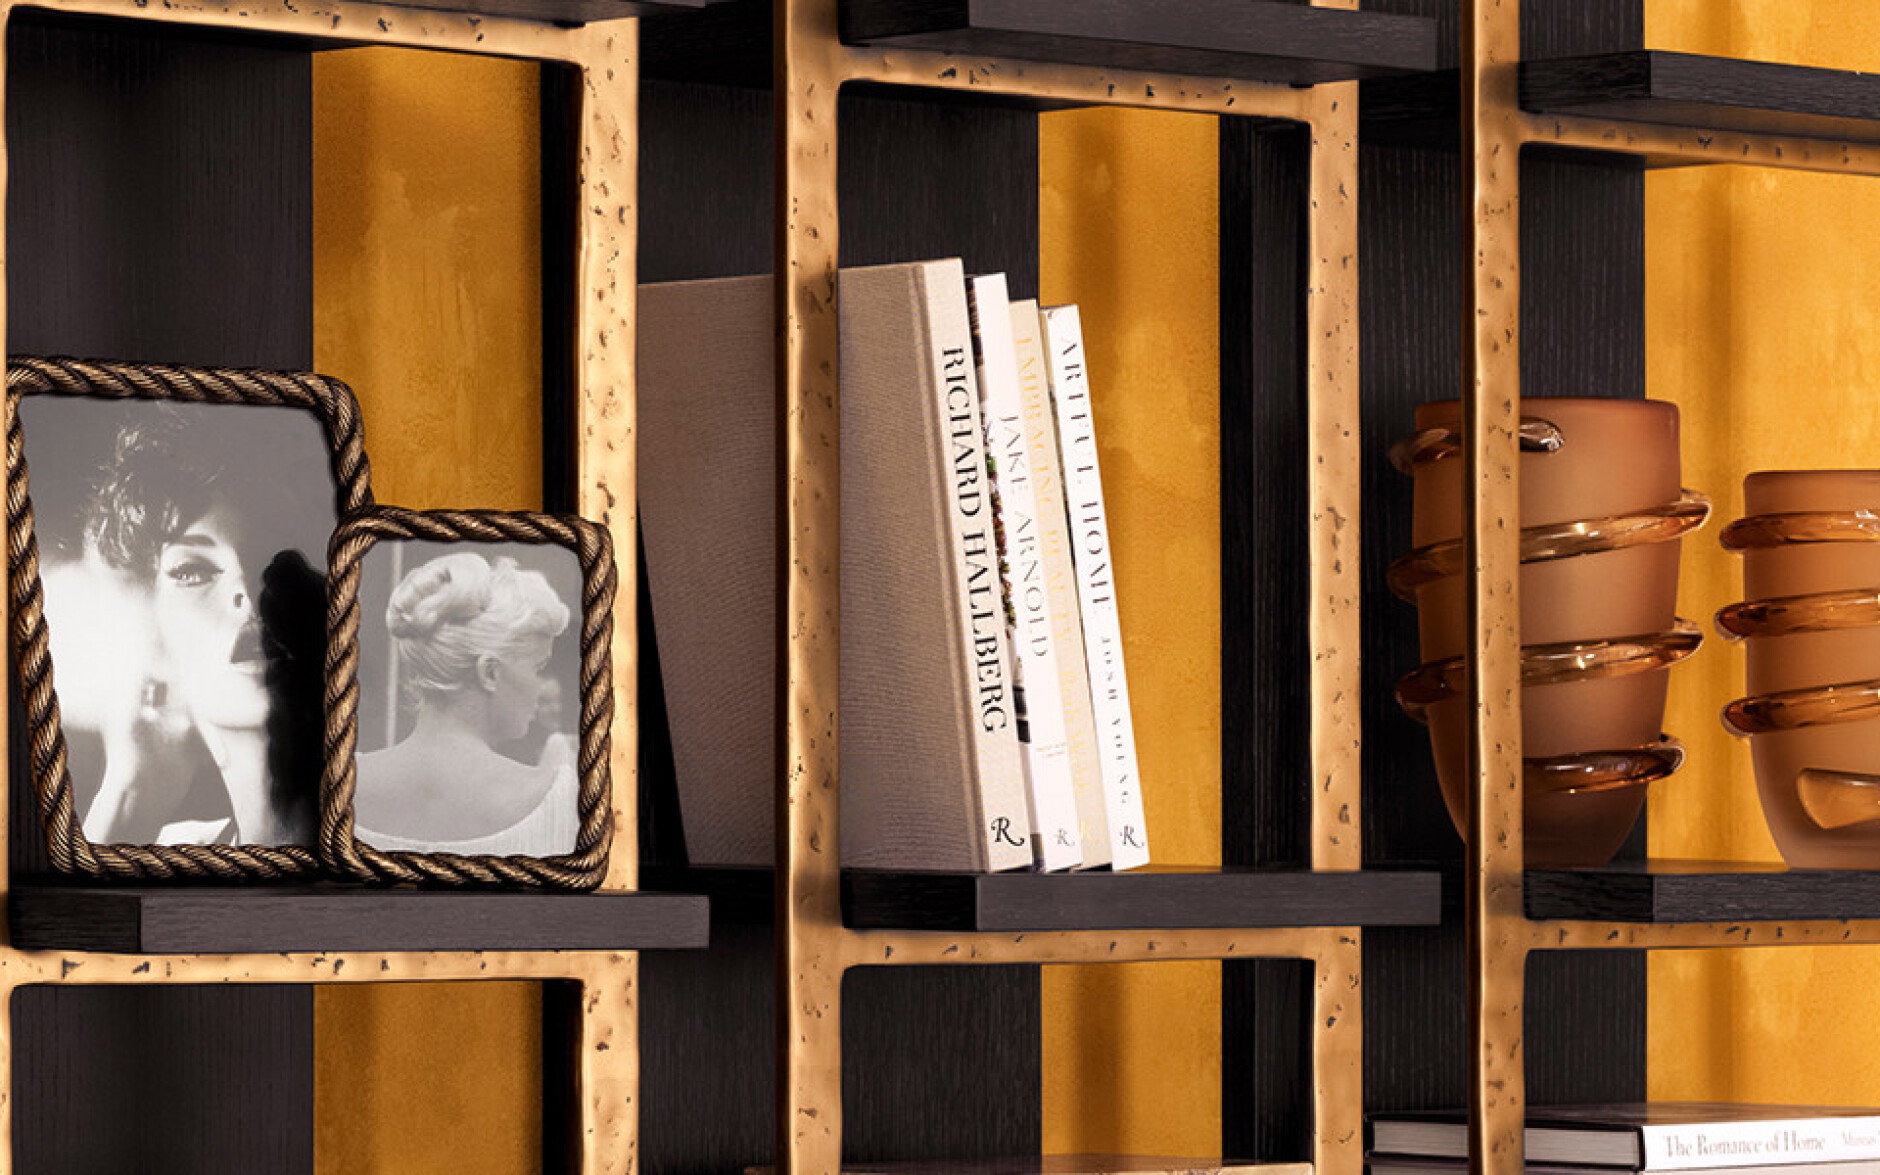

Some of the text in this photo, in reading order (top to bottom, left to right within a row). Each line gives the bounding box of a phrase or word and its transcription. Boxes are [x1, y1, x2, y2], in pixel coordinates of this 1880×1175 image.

[943, 347, 1007, 733] RICHARD HALLBERG
[1000, 416, 1047, 657] JAKE ARNOLD
[1062, 339, 1113, 613] ARTFUL HOME
[990, 816, 1025, 846] R
[1120, 825, 1145, 848] R
[1664, 1134, 1691, 1158] The
[1697, 1134, 1762, 1158] Romance
[1765, 1130, 1781, 1152] of
[1783, 1130, 1826, 1152] Home
